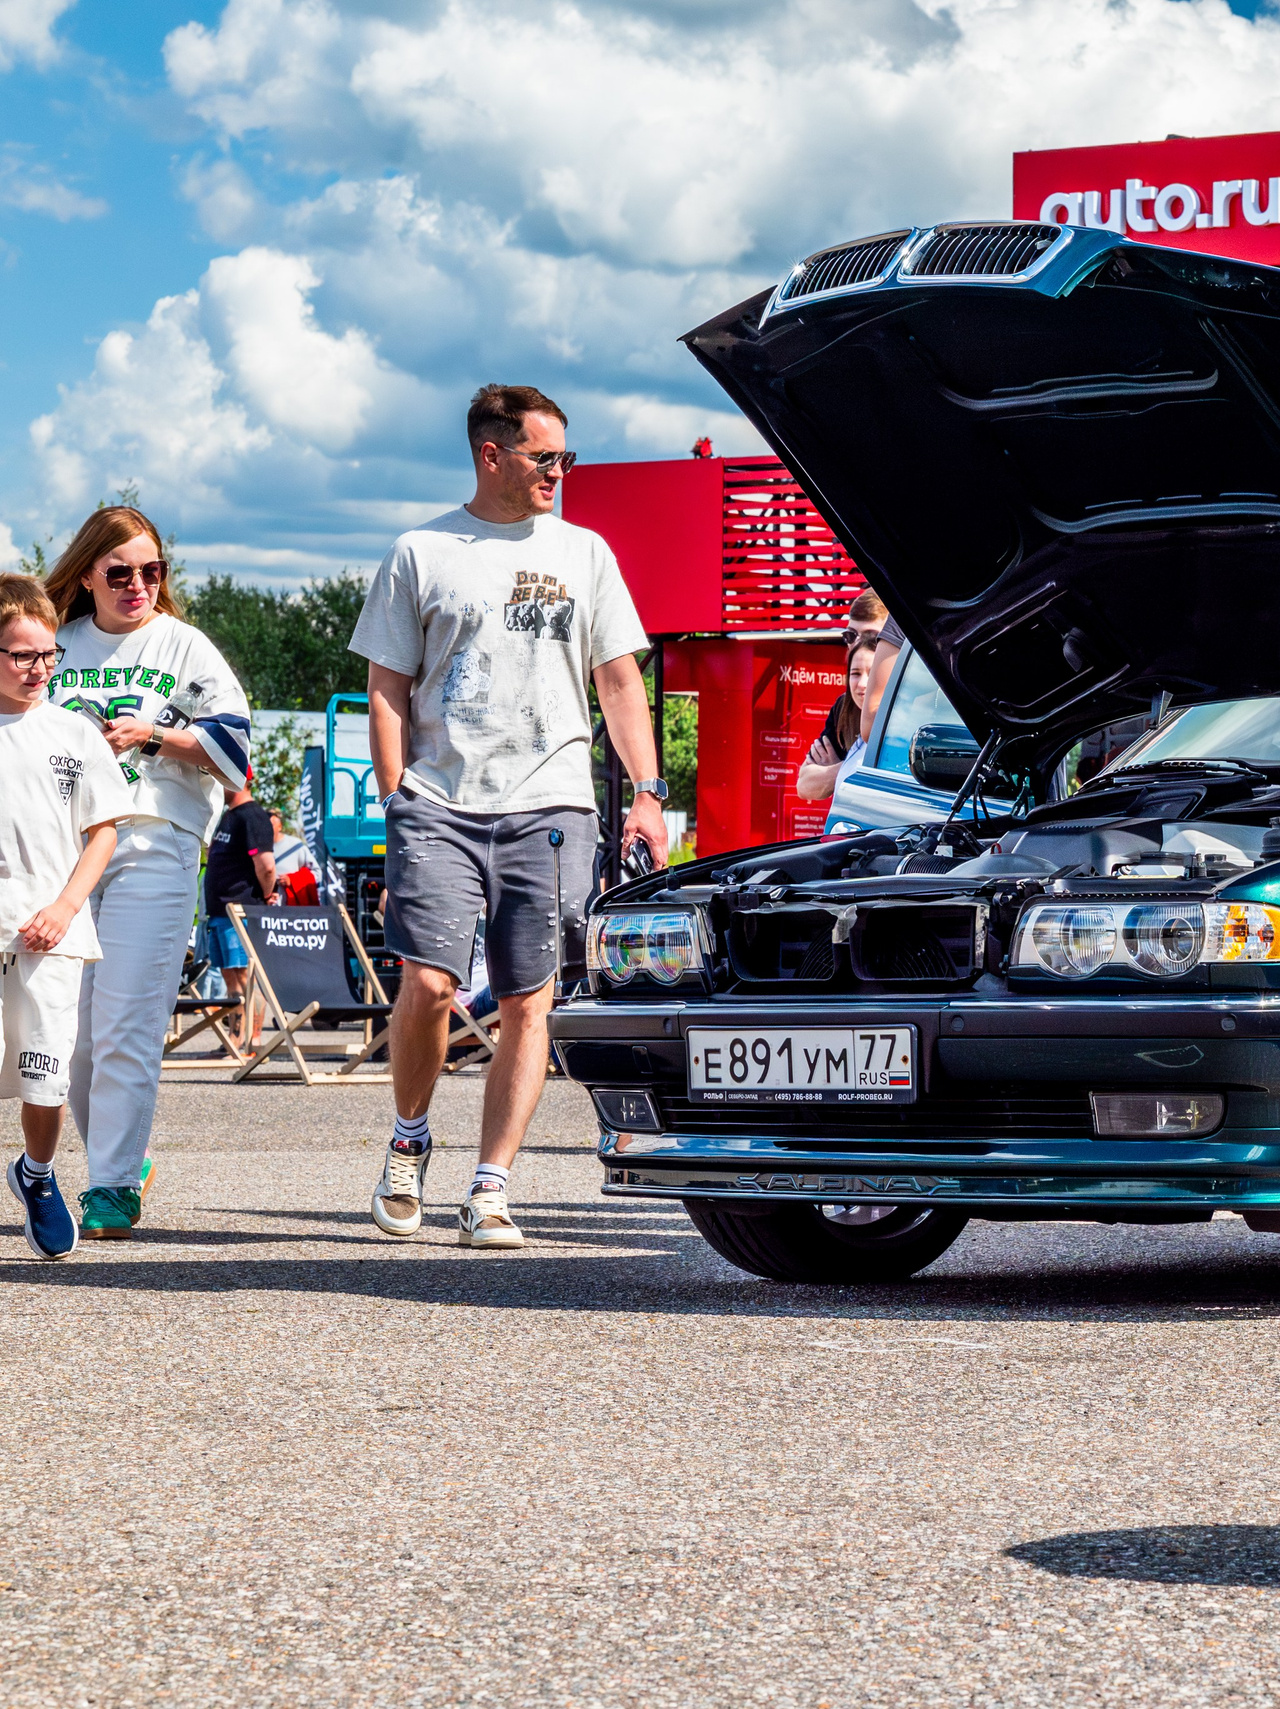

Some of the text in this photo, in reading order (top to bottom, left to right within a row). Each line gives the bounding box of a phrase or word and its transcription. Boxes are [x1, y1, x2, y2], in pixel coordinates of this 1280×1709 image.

[517, 571, 557, 586] Dom
[511, 585, 567, 605] REBEL
[47, 664, 176, 699] FOREVER
[779, 665, 815, 686] Ждём
[48, 755, 84, 772] OXFOR
[261, 916, 329, 931] пит-стоп
[266, 930, 327, 951] Авто.ру
[859, 1034, 897, 1070] 77
[859, 1072, 888, 1085] RUS
[703, 1092, 724, 1100] РОЛЬФ
[774, 1092, 792, 1101] (495)
[838, 1093, 893, 1101] ROLF-PROBEG.RU
